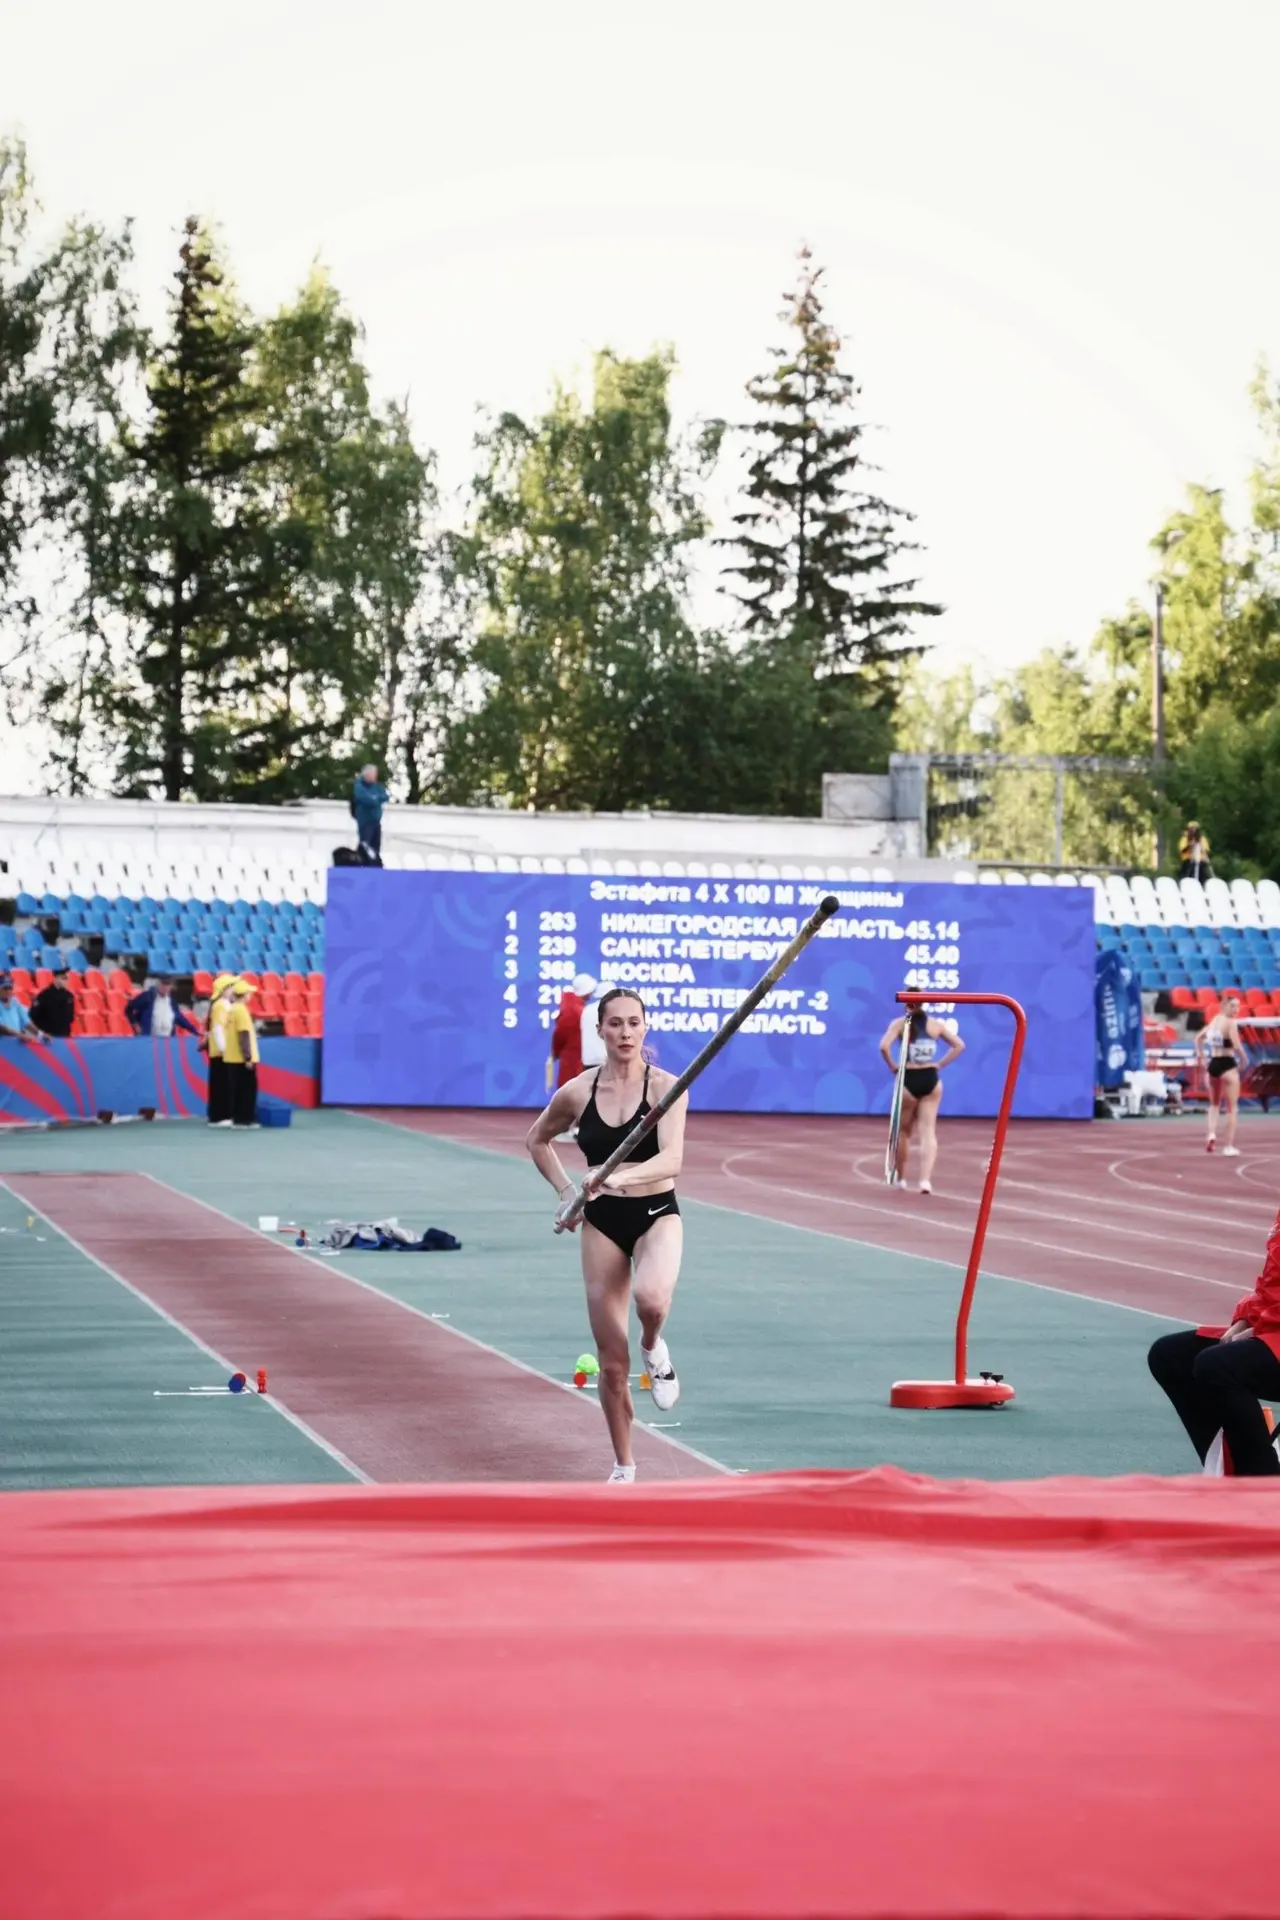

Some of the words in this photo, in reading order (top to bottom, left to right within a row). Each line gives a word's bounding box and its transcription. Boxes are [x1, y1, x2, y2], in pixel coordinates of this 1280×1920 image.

[590, 880, 691, 905] Эстафета
[694, 882, 710, 903] 4
[734, 884, 770, 905] 100
[774, 885, 794, 905] М
[505, 910, 518, 931] 1
[539, 911, 577, 932] 263
[601, 913, 797, 938] НИЖЕГОРОДСКАЯ
[800, 917, 904, 940] БЛАСТЬ
[905, 920, 960, 941] 45.14
[504, 934, 519, 956] 2
[538, 936, 577, 957] 239
[904, 944, 960, 965] 45.40
[504, 959, 519, 980] 3
[600, 961, 696, 984] МОСКВА
[904, 968, 960, 990] 45.55
[503, 983, 518, 1005] 4
[808, 990, 829, 1011] -2
[503, 1008, 518, 1029] 5
